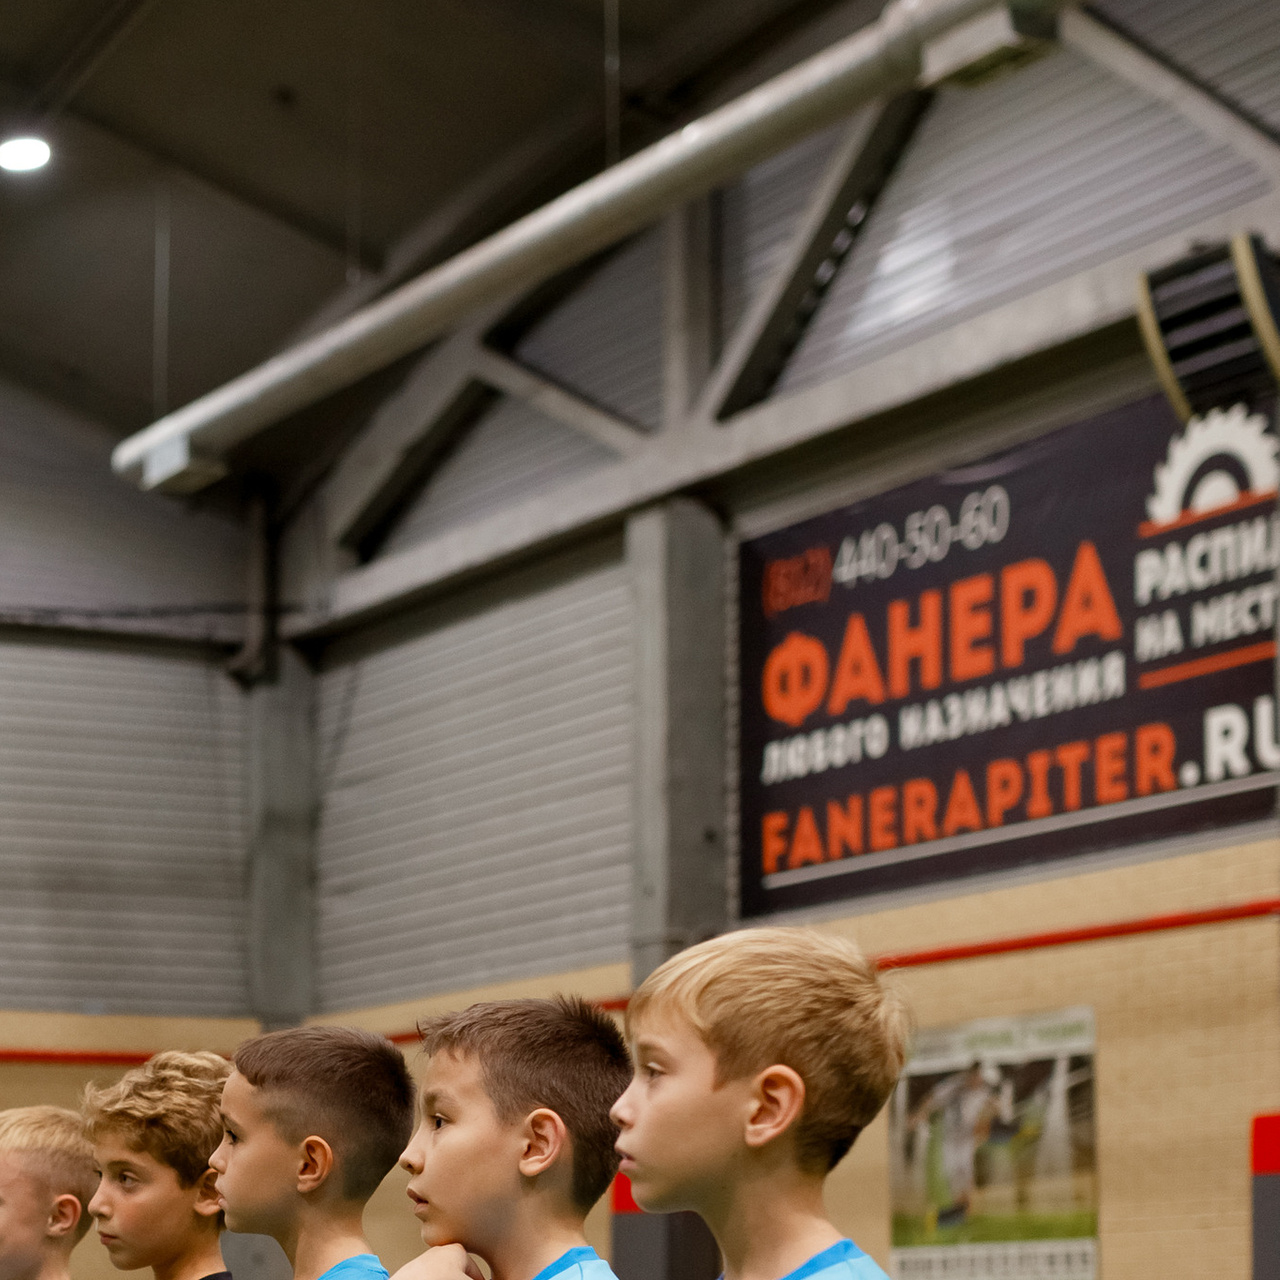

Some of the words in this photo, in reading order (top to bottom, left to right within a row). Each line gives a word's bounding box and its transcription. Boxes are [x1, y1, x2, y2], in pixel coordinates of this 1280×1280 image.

[1134, 512, 1280, 607] РАСПИ
[762, 539, 1123, 728] ФАНЕРА
[1134, 608, 1186, 664] НА
[761, 712, 890, 786] ЛЮБОГО
[899, 651, 1128, 752] НАЗНАЧЕНИЯ
